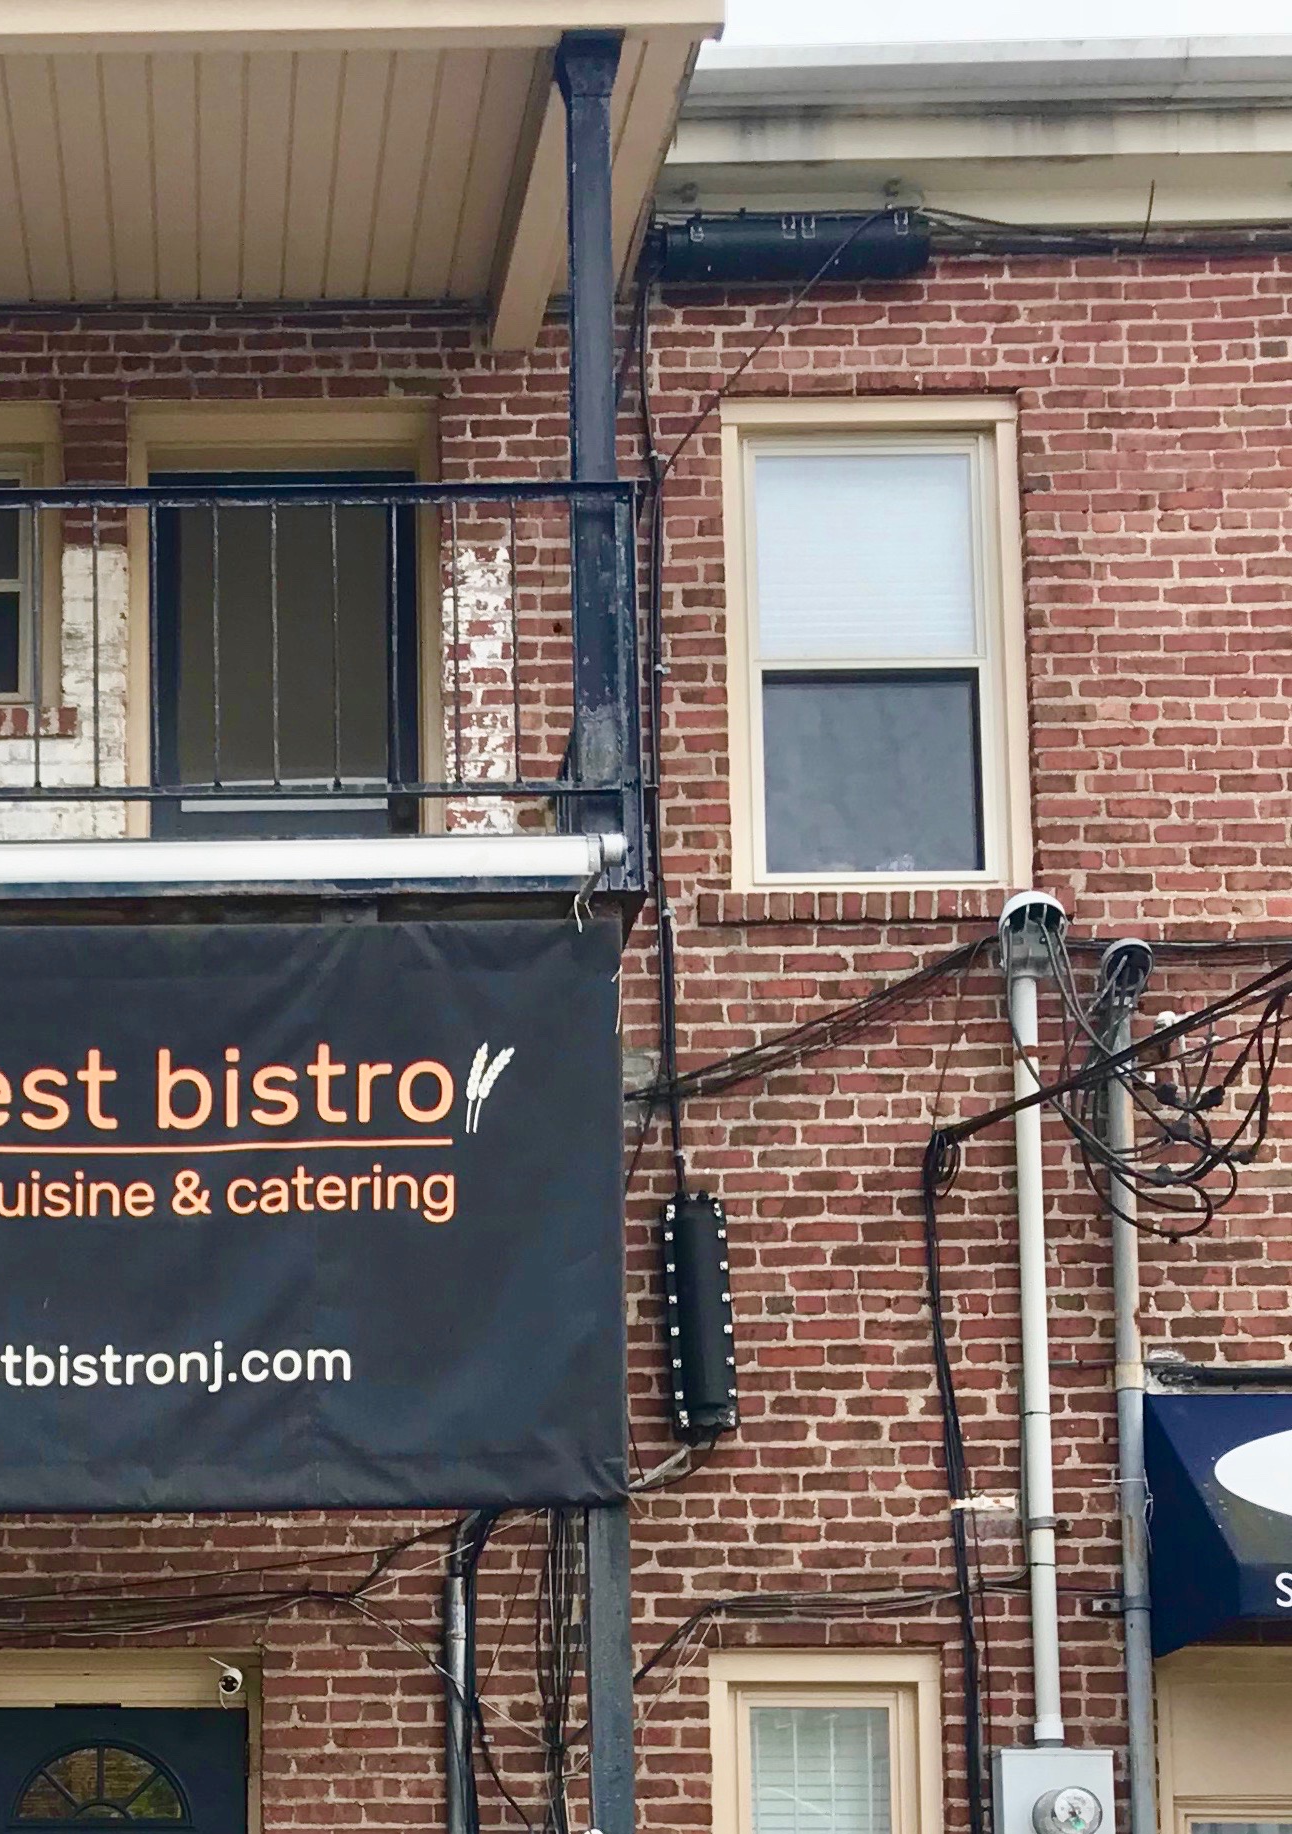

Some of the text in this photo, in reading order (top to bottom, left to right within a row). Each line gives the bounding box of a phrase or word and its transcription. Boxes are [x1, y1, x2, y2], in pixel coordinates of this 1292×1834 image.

[158, 1043, 454, 1130] bistro
[172, 1169, 212, 1215] &
[226, 1163, 455, 1223] catering
